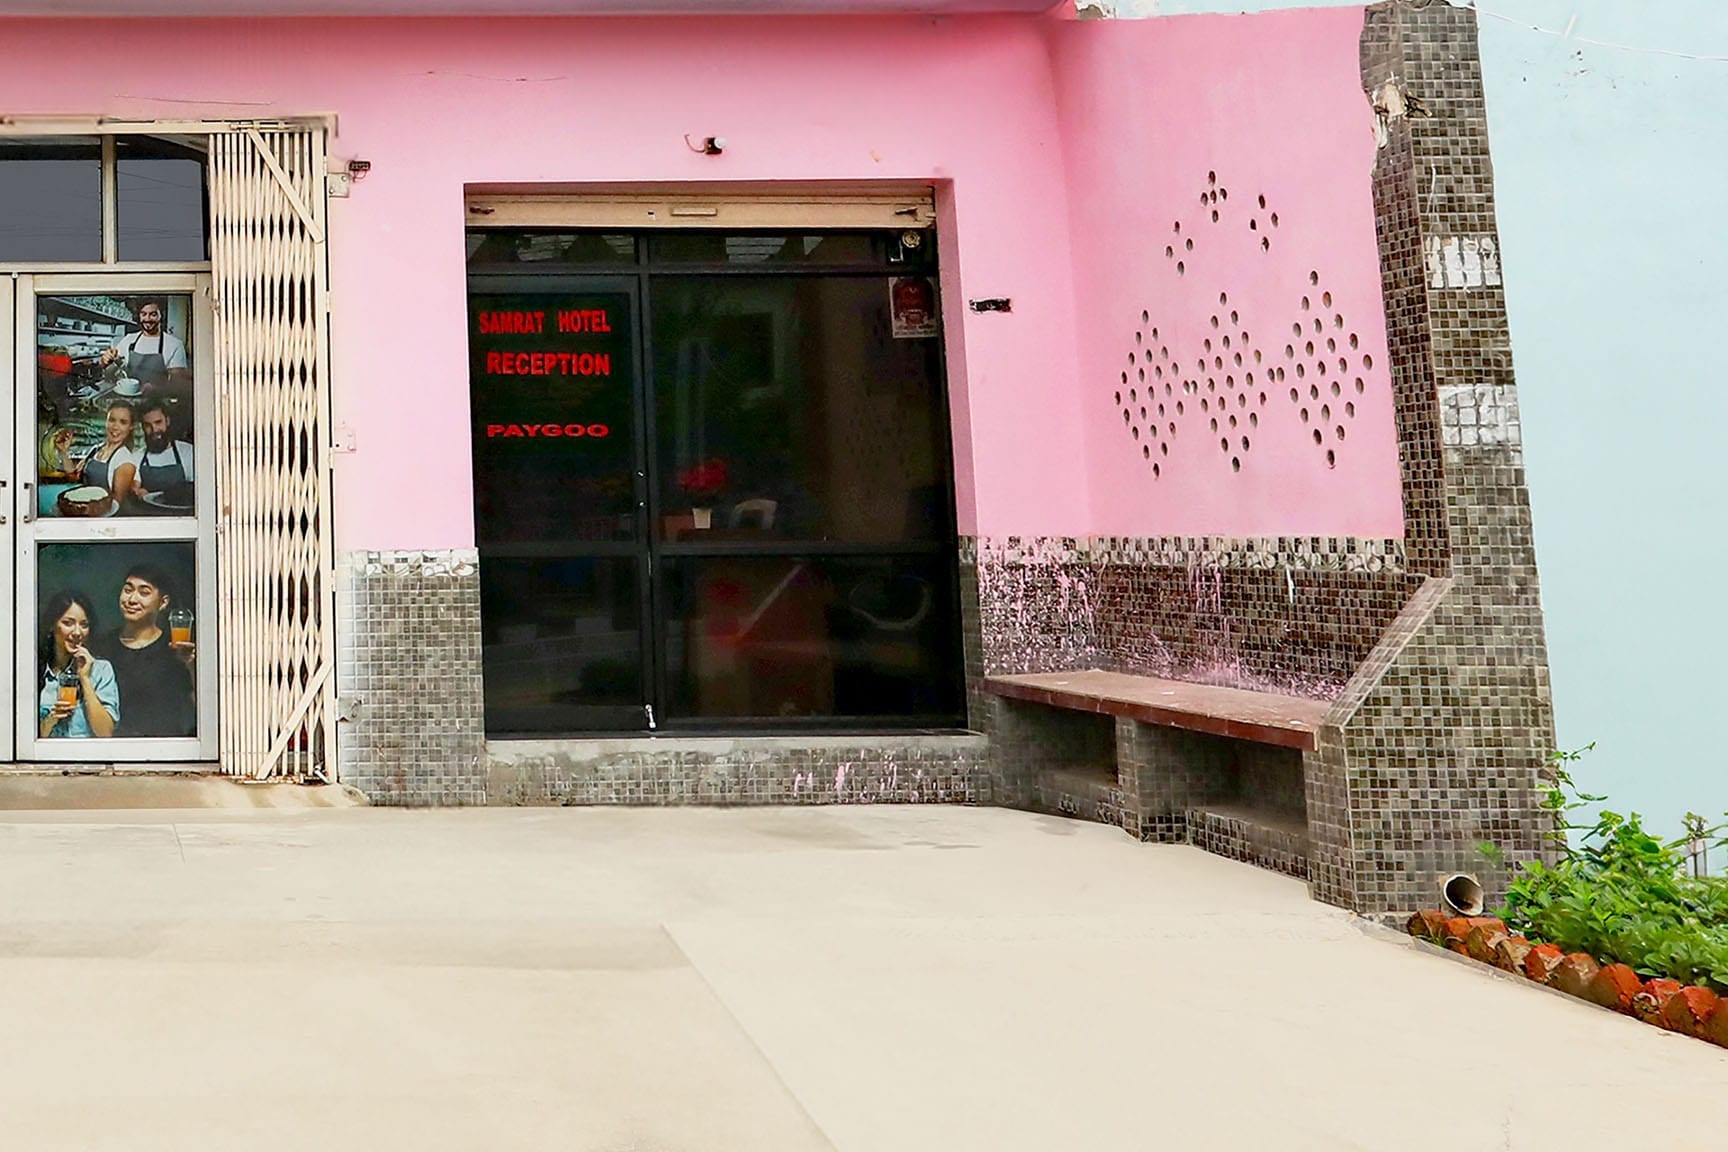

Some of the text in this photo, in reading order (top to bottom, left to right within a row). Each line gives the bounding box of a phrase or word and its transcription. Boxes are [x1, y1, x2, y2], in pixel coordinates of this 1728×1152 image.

[479, 309, 611, 334] SAMRAT HOTEL
[487, 352, 610, 375] RECEPTION
[487, 424, 609, 437] PAYGOO
